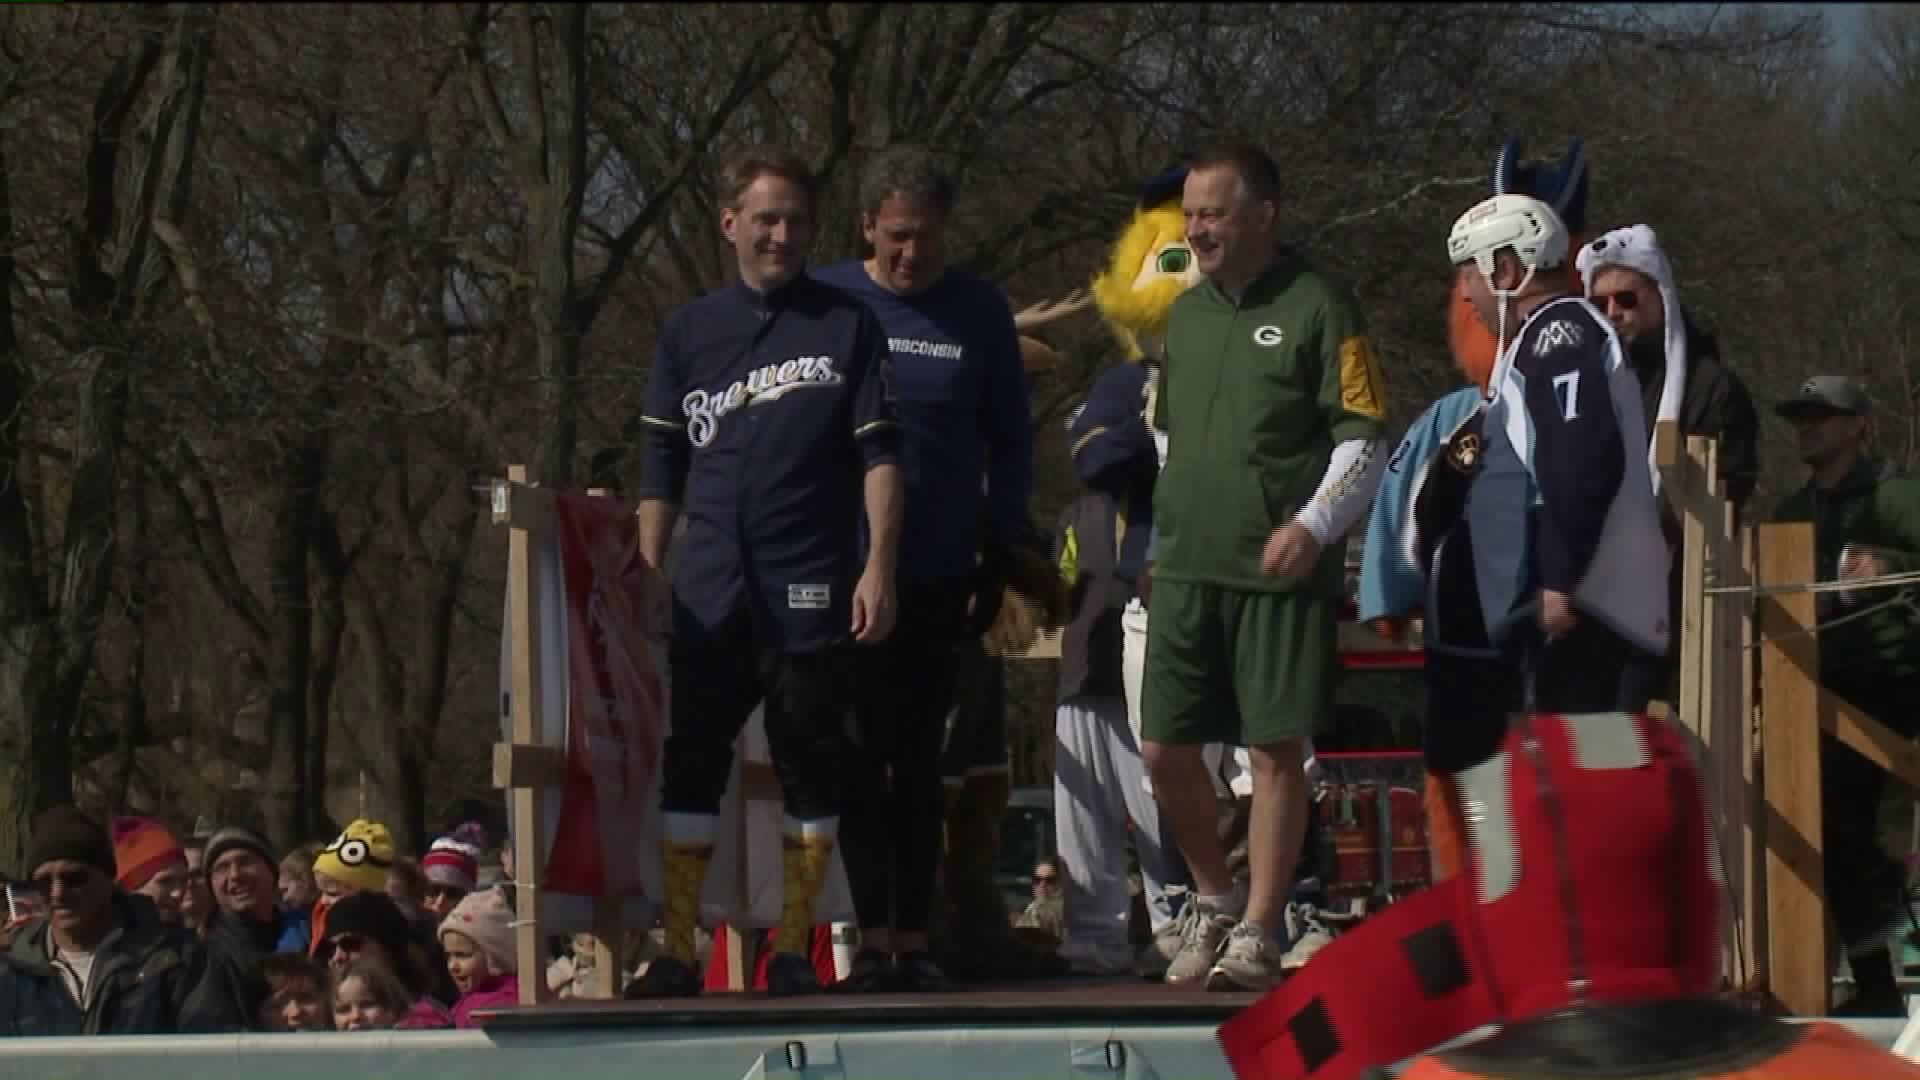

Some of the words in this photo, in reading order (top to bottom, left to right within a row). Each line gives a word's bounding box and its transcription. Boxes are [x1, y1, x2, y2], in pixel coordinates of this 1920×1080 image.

[1253, 324, 1284, 346] G
[682, 355, 840, 448] Brewers
[1552, 369, 1580, 421] 7
